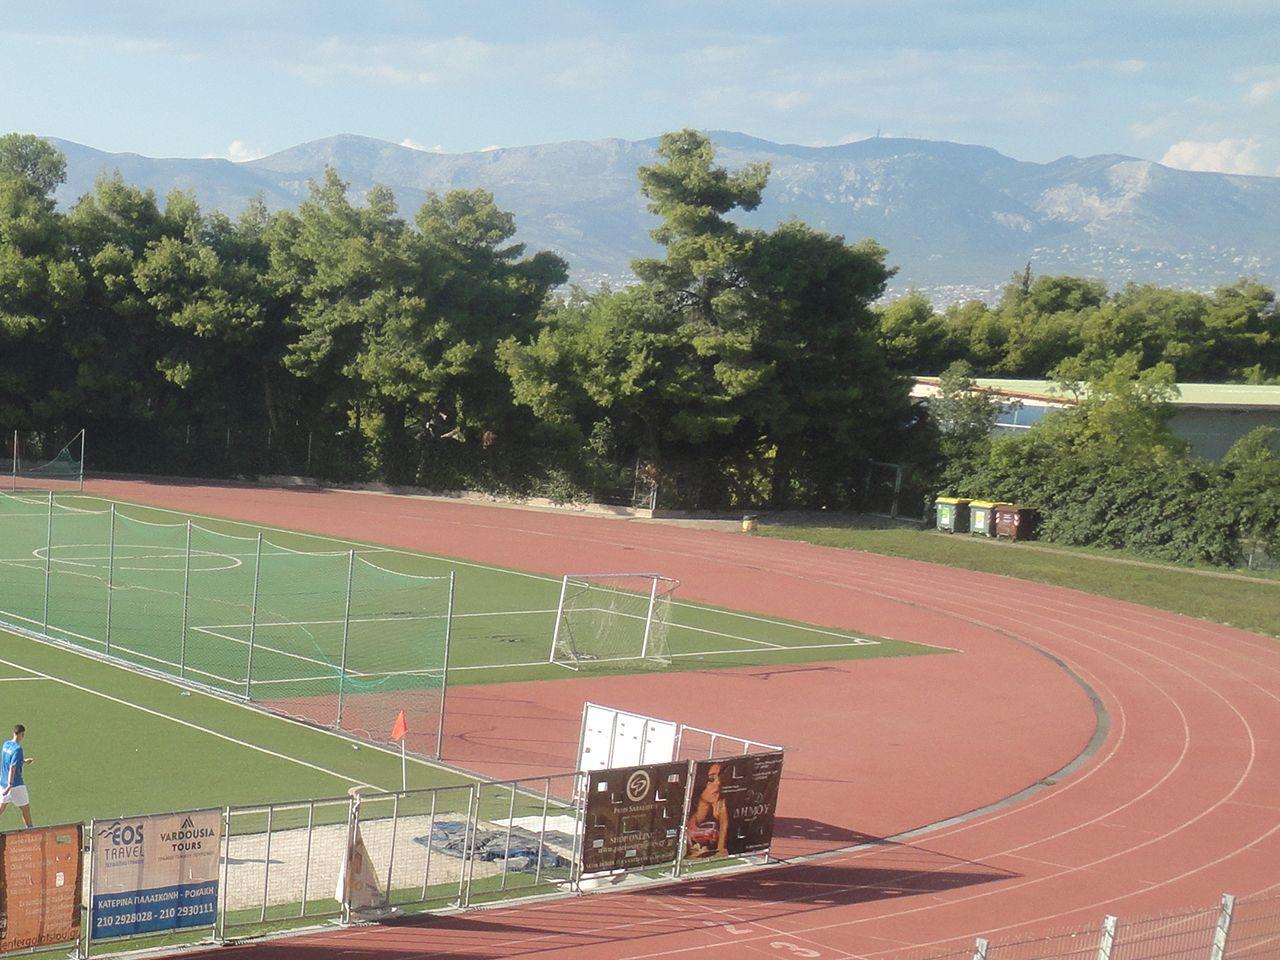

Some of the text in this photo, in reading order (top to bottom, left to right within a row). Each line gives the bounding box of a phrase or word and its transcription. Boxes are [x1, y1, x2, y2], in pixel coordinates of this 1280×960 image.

[111, 822, 144, 846] EOS
[160, 828, 215, 842] VARDOUSIA
[104, 845, 145, 861] TRAVEL
[171, 840, 202, 852] TOURS
[98, 898, 133, 909] ΚΑΤΕΡΙΝΑ
[134, 891, 179, 904] ΠΑΛΑΣΚΩΝΗ
[96, 917, 113, 928] 210
[114, 911, 153, 926] 2928028
[159, 907, 176, 920] 210
[177, 902, 215, 917] 2930111
